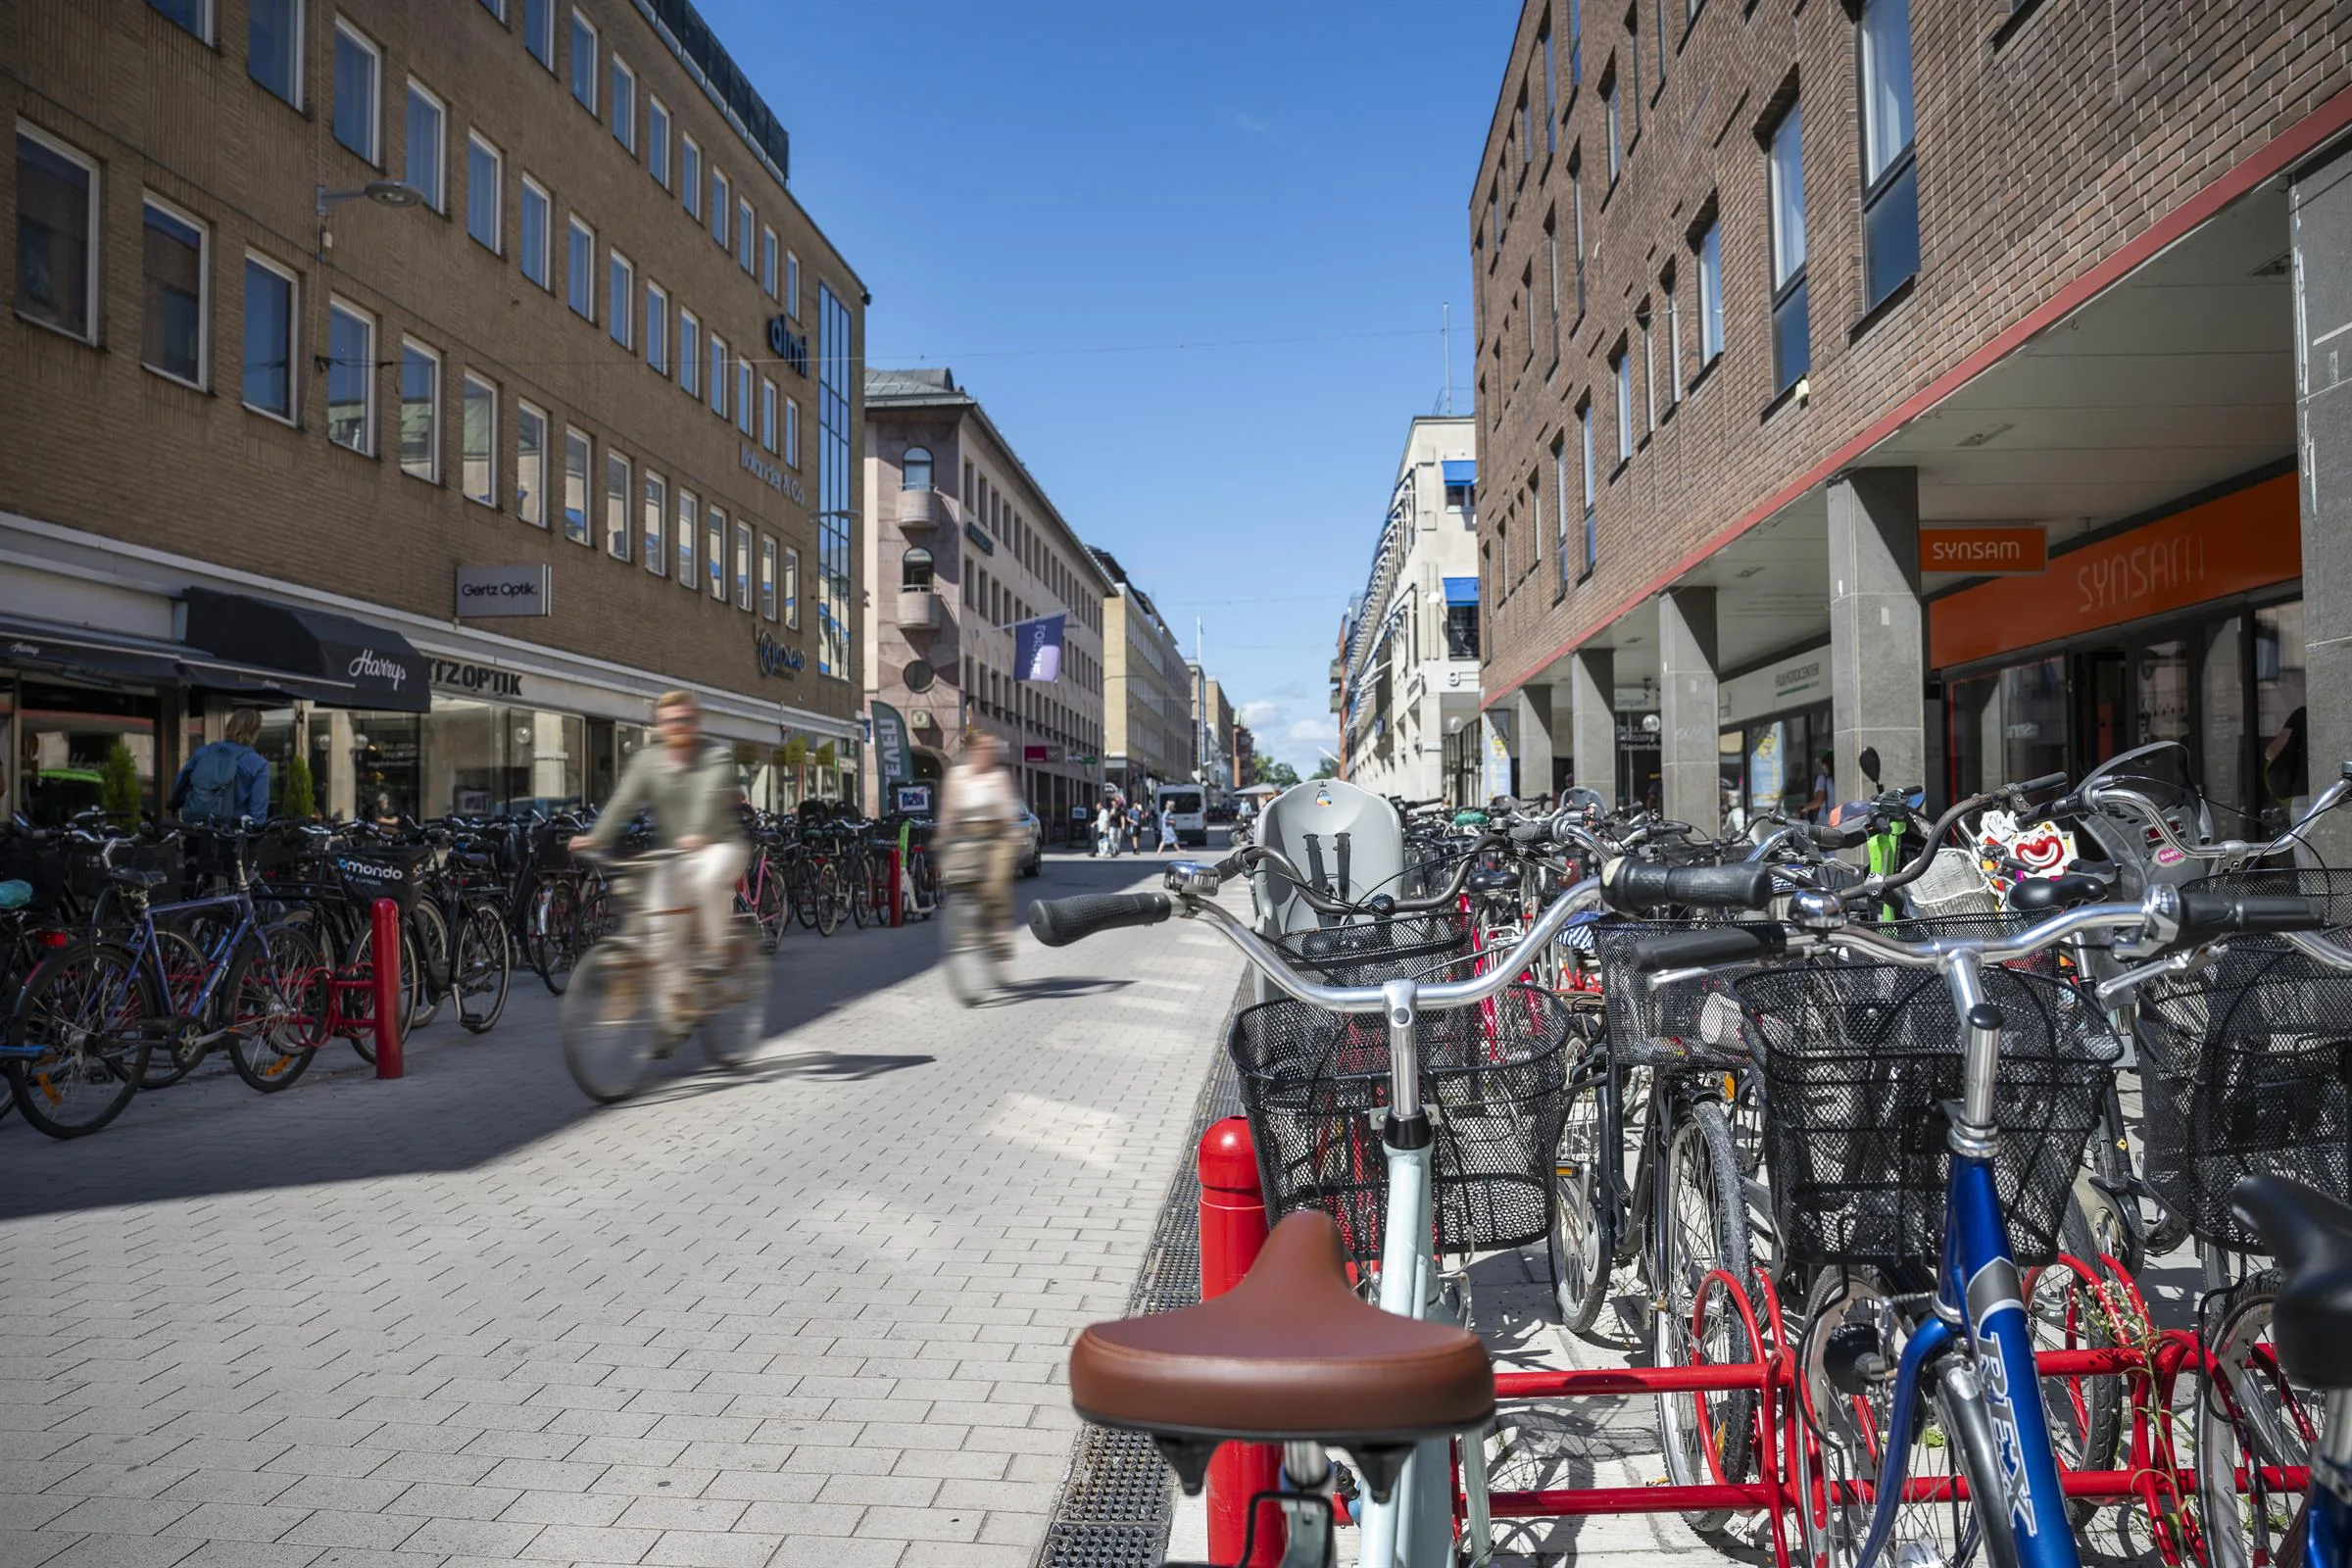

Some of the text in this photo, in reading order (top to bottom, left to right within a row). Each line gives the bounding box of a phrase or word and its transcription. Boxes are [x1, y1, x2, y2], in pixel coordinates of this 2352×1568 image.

[768, 314, 808, 378] almi
[1933, 541, 2020, 560] SYNSAM
[462, 583, 498, 596] Gertz
[2077, 532, 2205, 614] SYNSAM
[348, 649, 407, 691] Harrys
